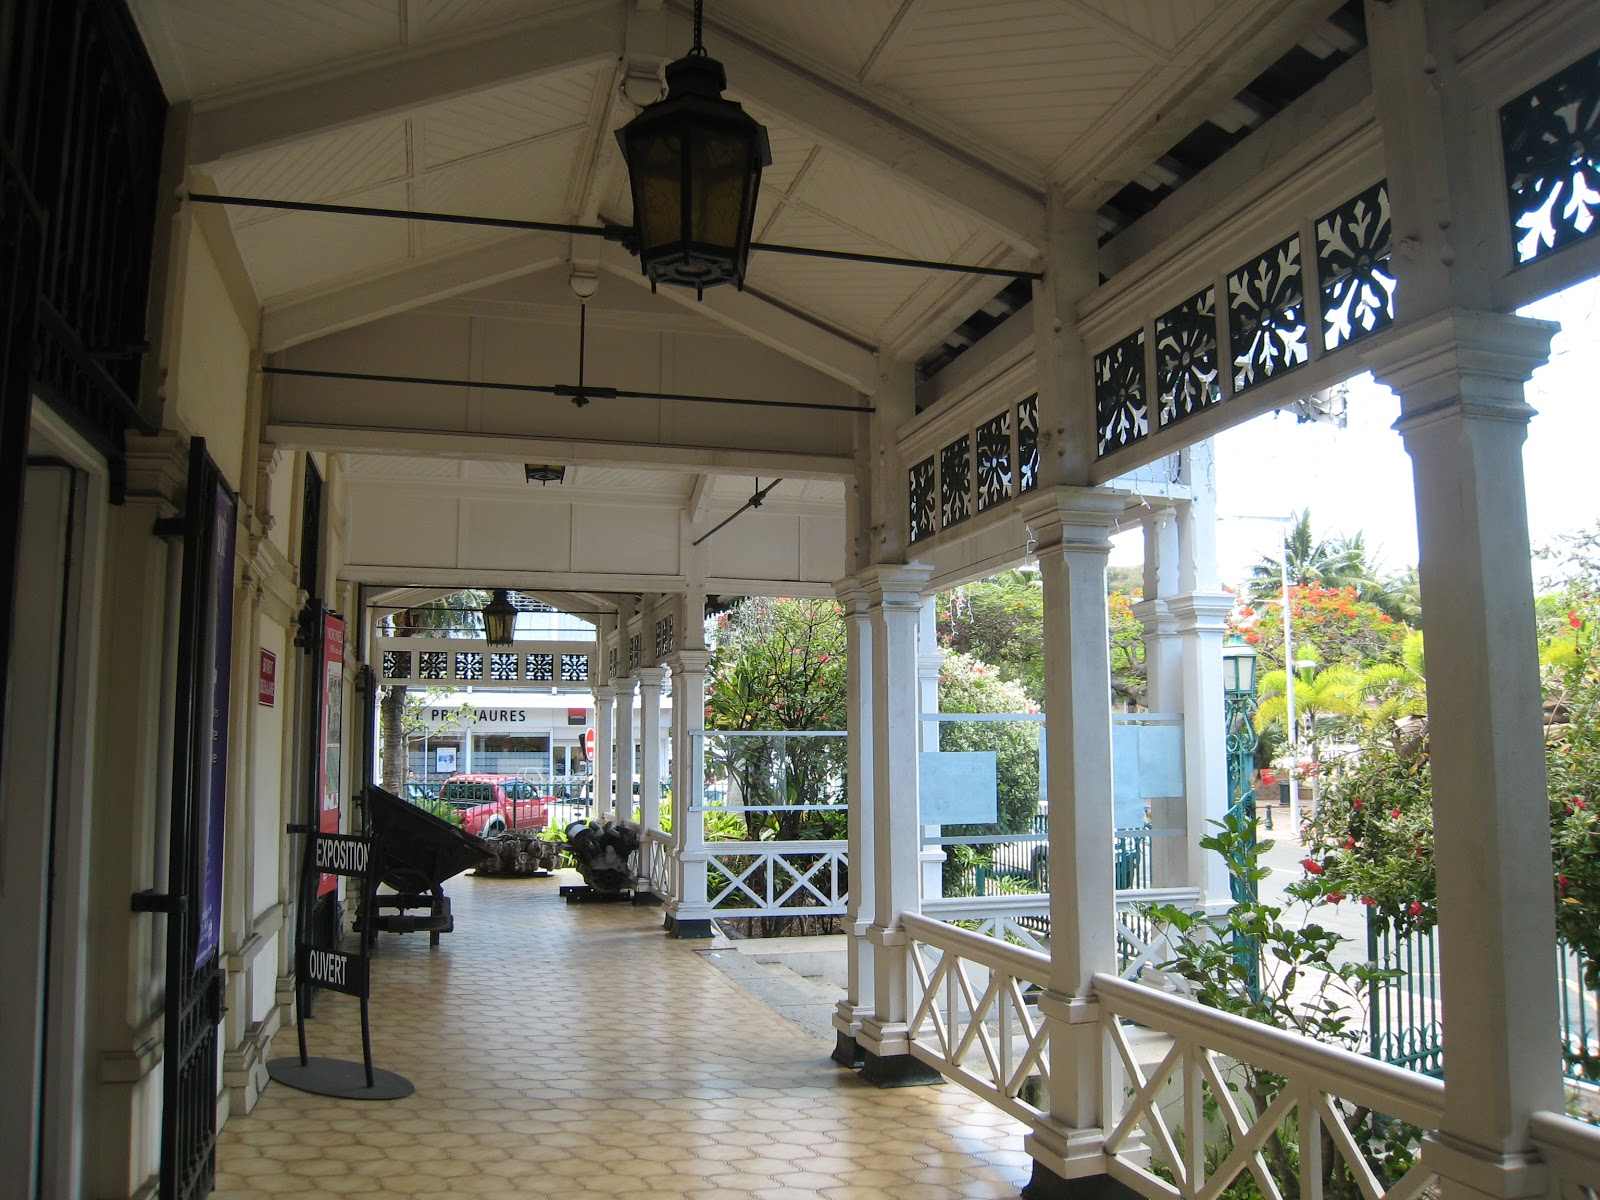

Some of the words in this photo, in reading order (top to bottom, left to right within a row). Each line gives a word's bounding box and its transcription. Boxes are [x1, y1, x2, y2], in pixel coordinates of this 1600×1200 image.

[473, 710, 526, 724] JAURES
[316, 839, 370, 872] EXPOSITION
[309, 949, 347, 985] OUVERT
